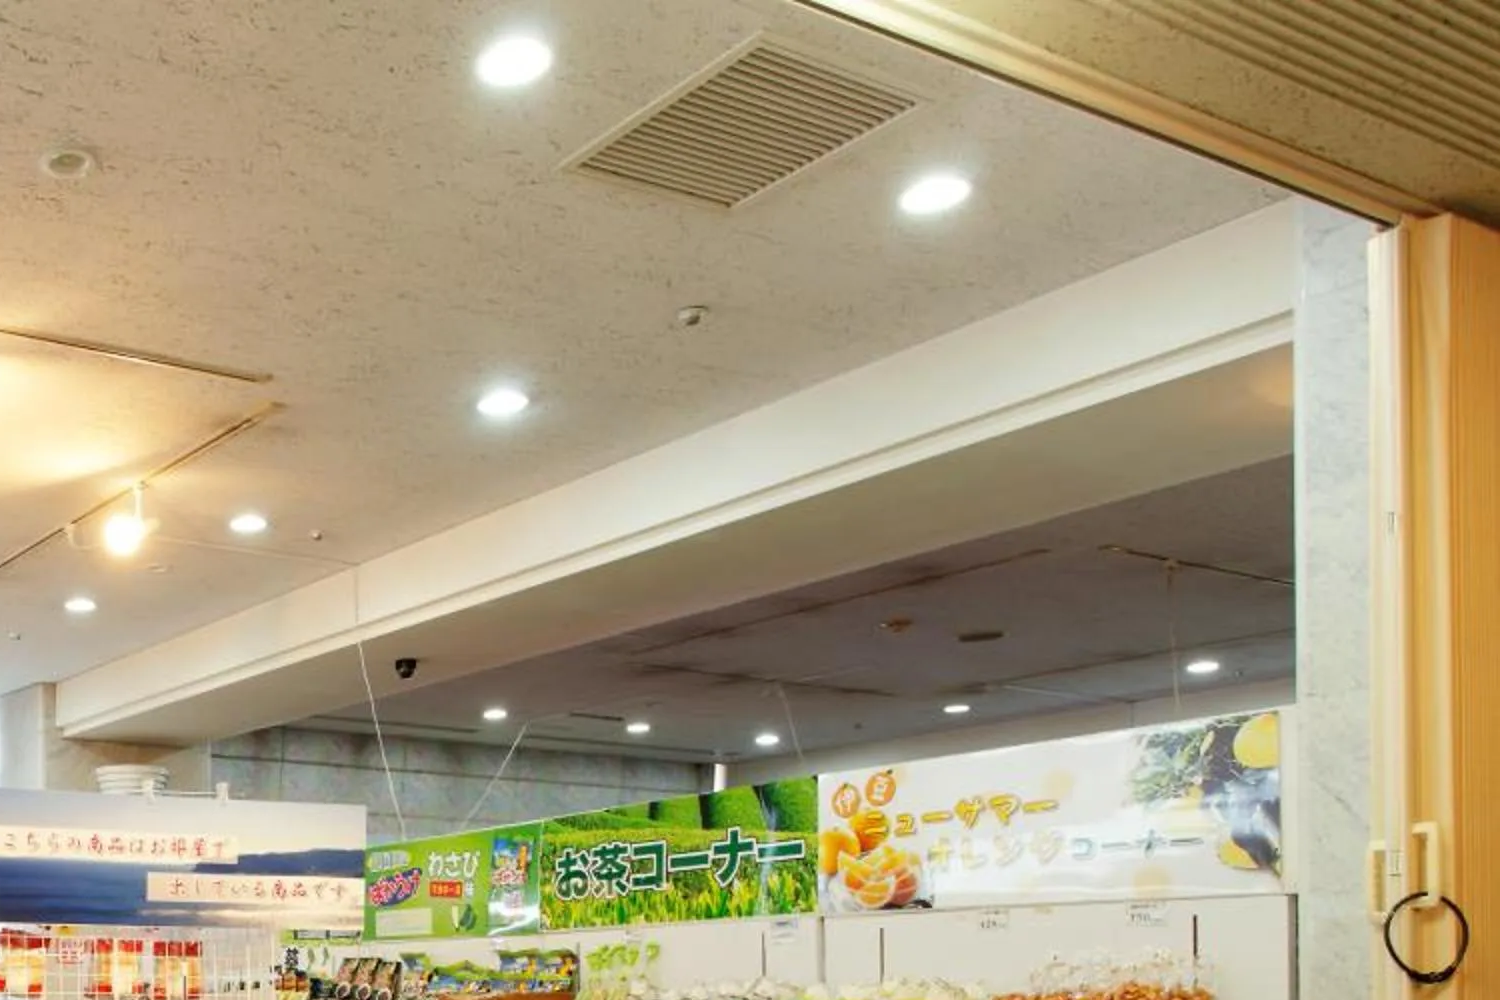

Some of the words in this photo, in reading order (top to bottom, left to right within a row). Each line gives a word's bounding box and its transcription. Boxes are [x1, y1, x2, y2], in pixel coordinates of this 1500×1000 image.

[863, 793, 1059, 837] ニューサマー
[428, 851, 480, 878] わさび
[555, 826, 806, 900] お茶コーナー
